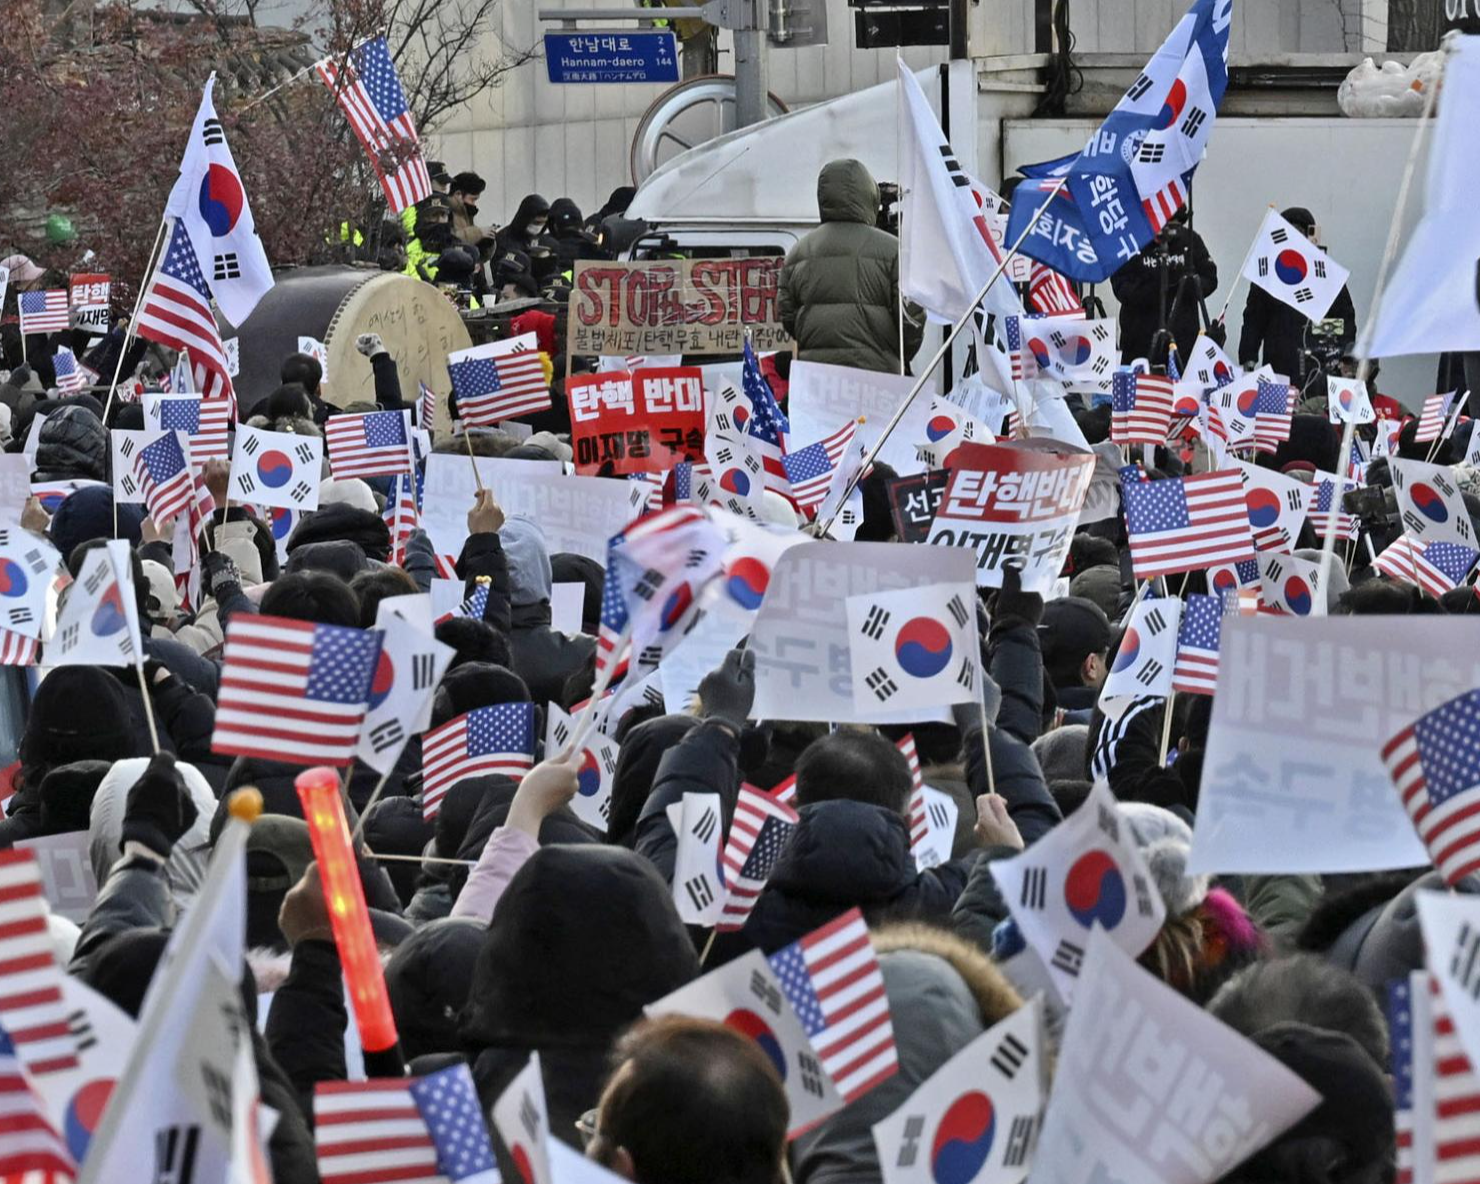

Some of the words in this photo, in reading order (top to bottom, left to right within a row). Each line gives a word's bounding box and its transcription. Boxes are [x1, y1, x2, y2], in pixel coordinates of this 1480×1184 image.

[569, 36, 632, 53] 한남대로
[658, 35, 664, 44] 2
[561, 57, 645, 67] Hannam-daero
[656, 58, 672, 66] 144
[72, 282, 110, 305] 탄핵
[709, 329, 740, 349] 내란
[571, 381, 634, 422] 탄핵
[644, 377, 701, 413] 반대
[577, 429, 650, 465] 이재명
[946, 461, 1095, 519] 탄핵반대
